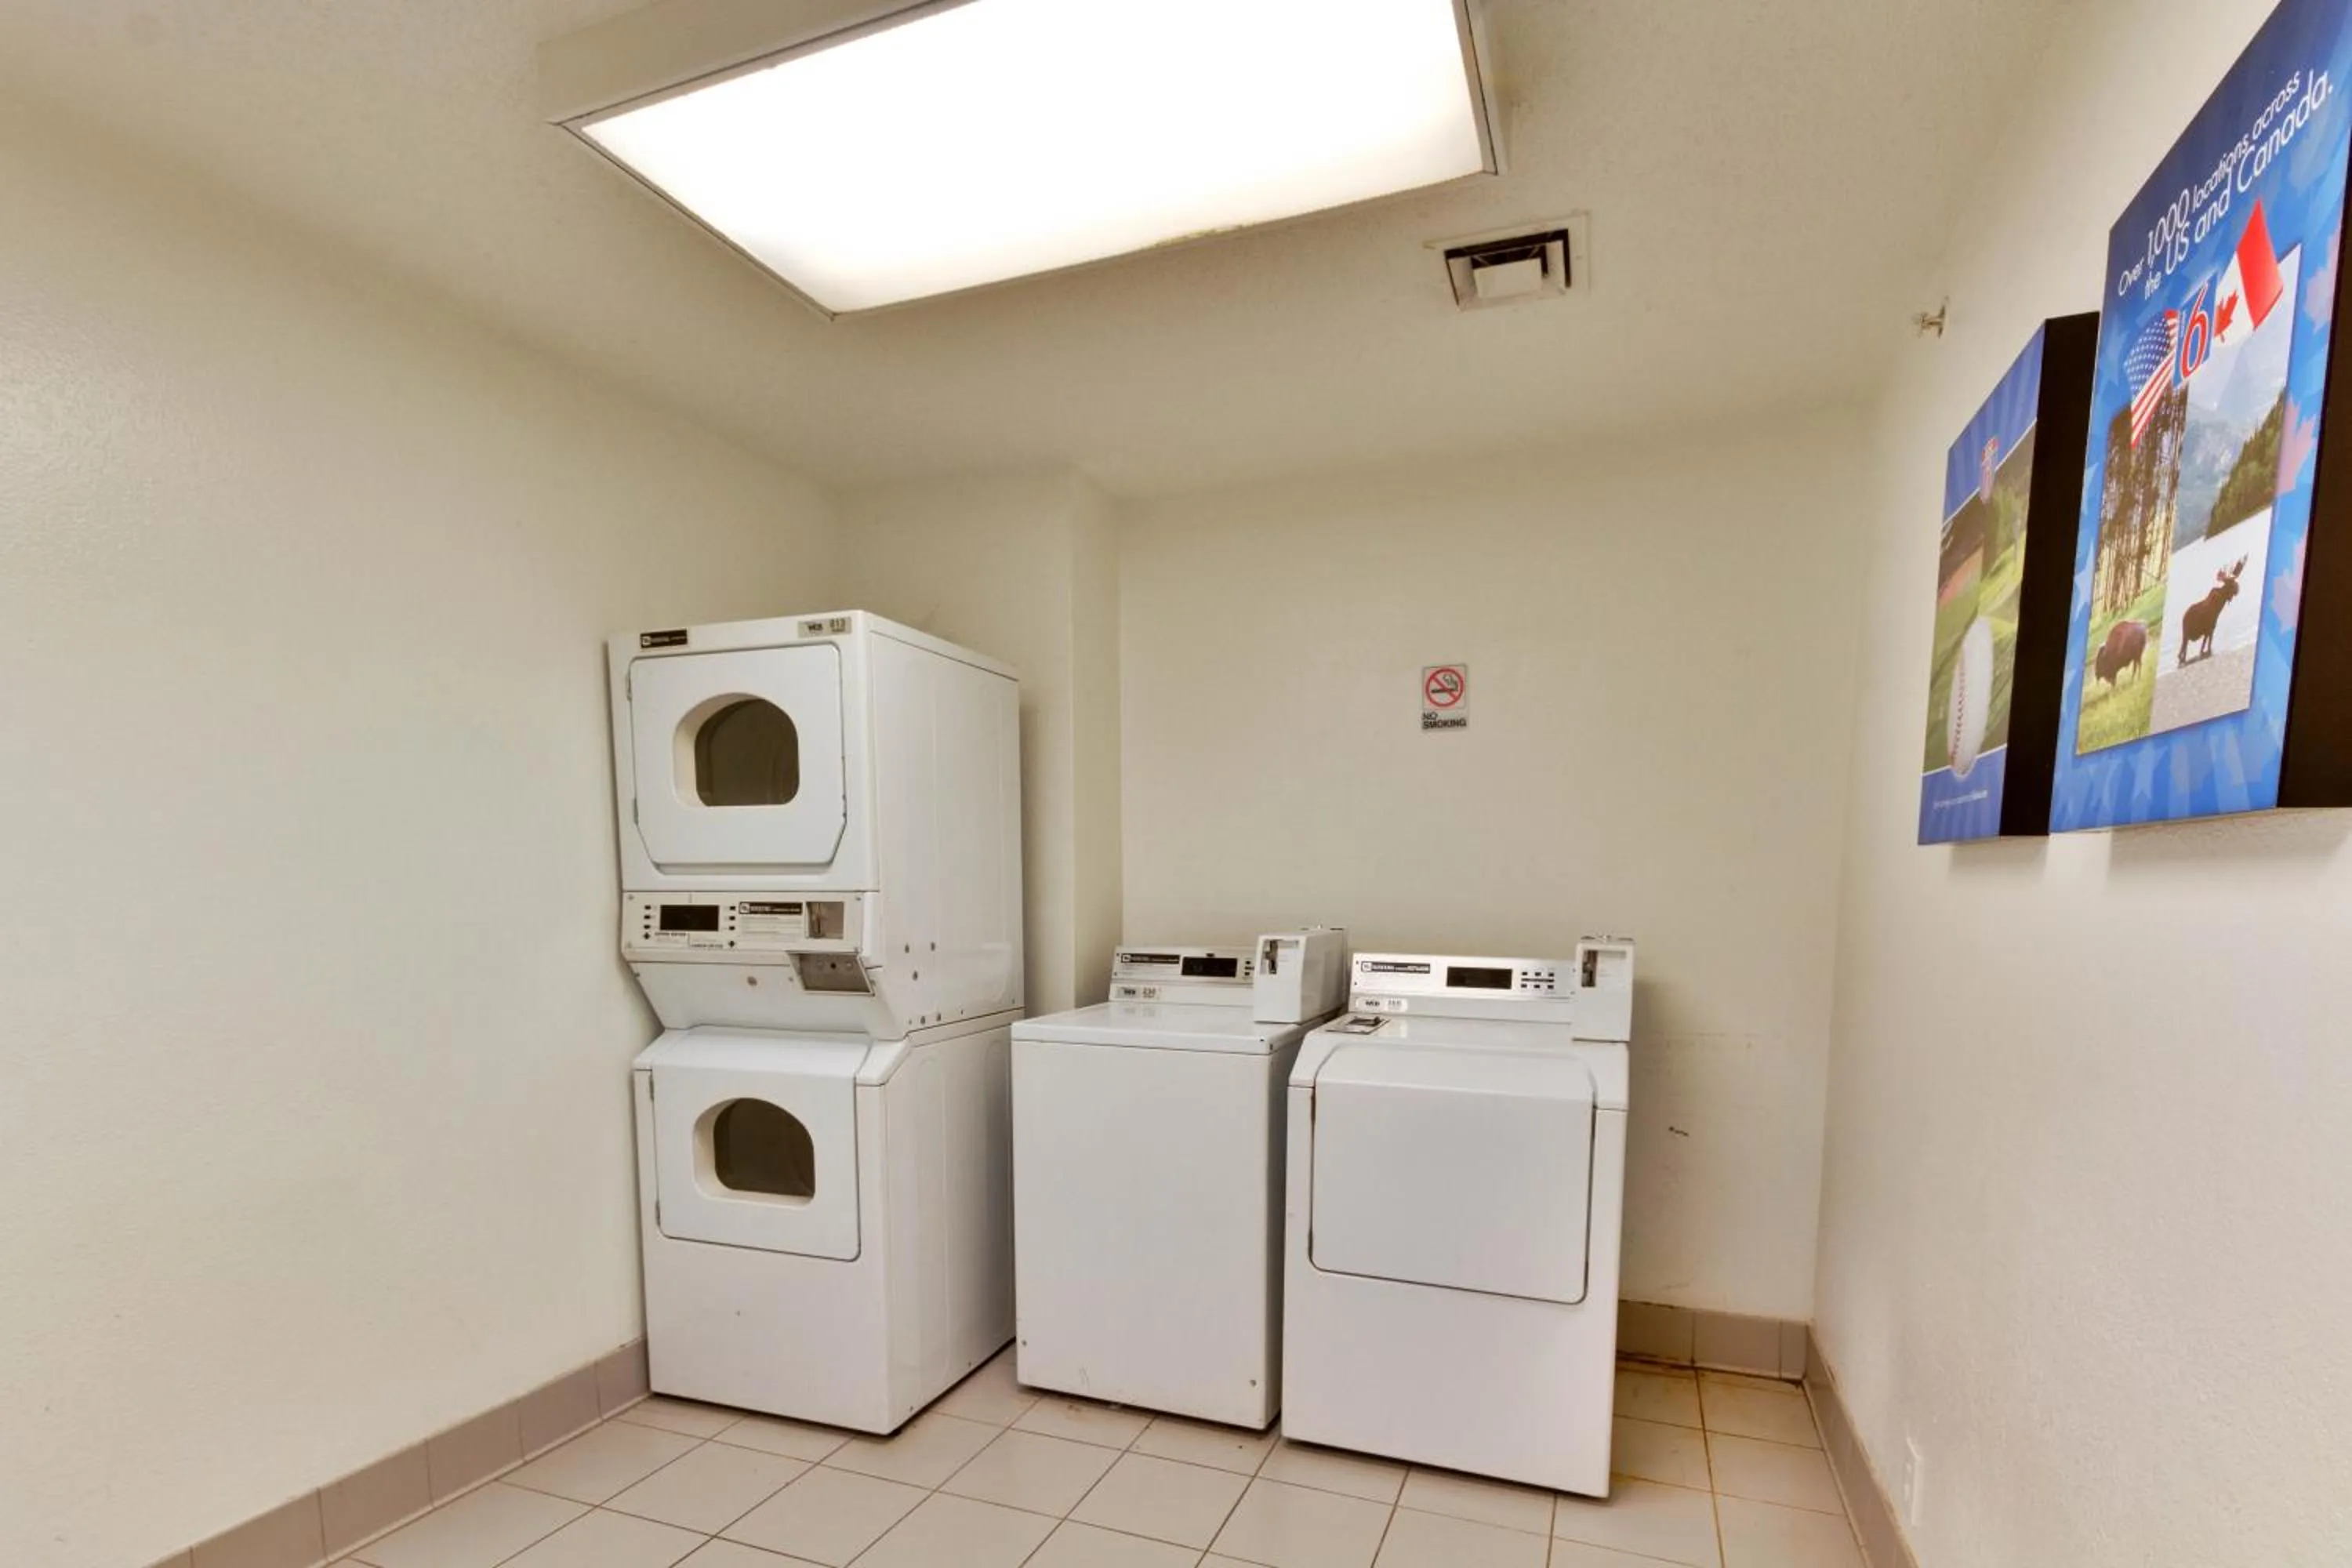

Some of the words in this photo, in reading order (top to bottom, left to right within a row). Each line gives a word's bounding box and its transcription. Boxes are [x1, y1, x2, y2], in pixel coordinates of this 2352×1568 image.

[2118, 257, 2144, 296] Over
[2192, 133, 2249, 213] locations
[2252, 71, 2300, 140] across
[2144, 271, 2161, 300] the
[2165, 220, 2190, 274] US
[2194, 160, 2233, 243] and
[2237, 68, 2333, 193] Canada.
[2181, 281, 2209, 378] 6
[1422, 711, 1438, 720] NO
[1422, 717, 1467, 730] SMOKING
